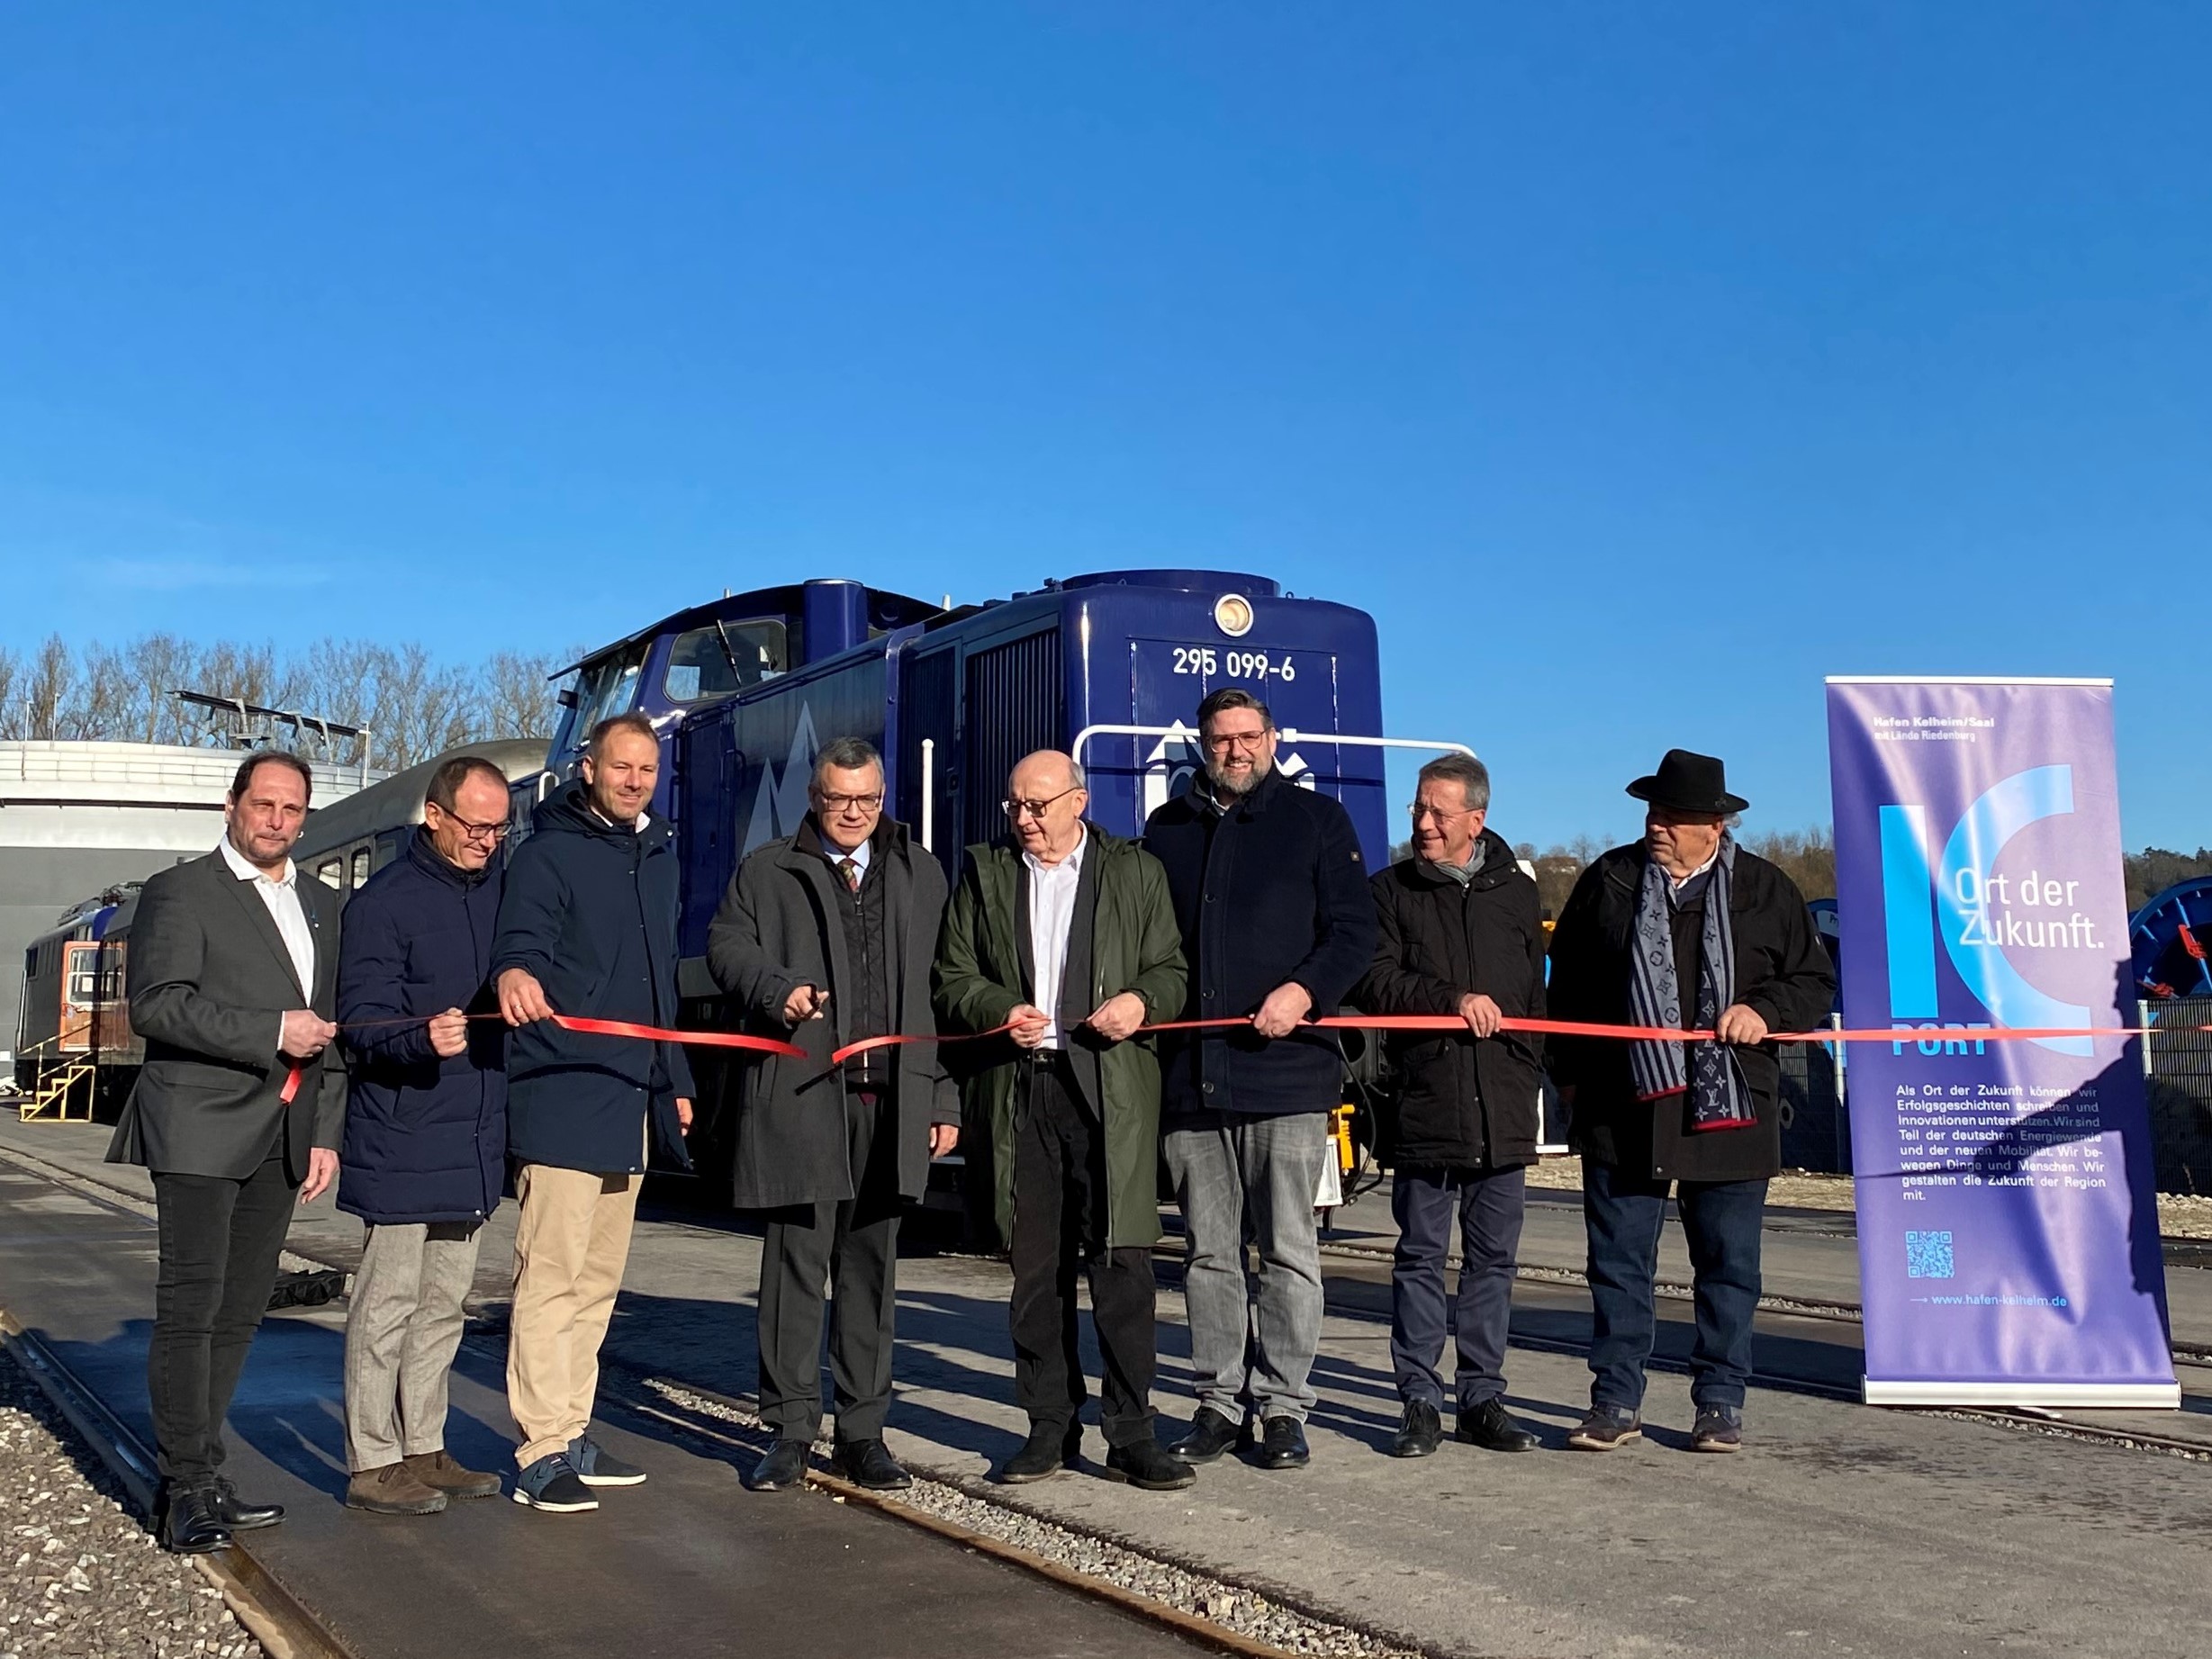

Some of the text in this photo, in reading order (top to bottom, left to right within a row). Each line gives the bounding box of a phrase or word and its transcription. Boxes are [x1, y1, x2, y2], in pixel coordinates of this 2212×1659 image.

[1173, 647, 1295, 681] 295 099-6
[1873, 717, 1994, 727] Hafen Kelheim/Saal
[1874, 731, 1889, 740] mit
[1921, 730, 1975, 743] Riedenburg
[1955, 867, 2079, 907] Ort der
[1957, 908, 2104, 950] Zukunft.
[1891, 1023, 1991, 1056] PORT
[1896, 1085, 2097, 1097] Als Ort der Zukunft können wir
[1897, 1100, 2099, 1113] Erfolgsgeschichten schreiben und
[1898, 1114, 1976, 1125] Innovationen
[2054, 1117, 2074, 1127] Wir
[2075, 1117, 2100, 1127] sind
[1899, 1129, 2101, 1144] Teil der deutschen Energiewende
[1901, 1144, 1923, 1155] und
[1929, 1144, 1949, 1155] der
[1955, 1145, 1992, 1156] neuen
[2057, 1146, 2078, 1158] Wir
[2084, 1146, 2103, 1158] be-
[1901, 1159, 2104, 1172] wegen Dinge und Menschen. Wir
[1902, 1175, 2106, 1189] gestalten die Zukunft der Region
[1903, 1189, 1926, 1201] mit.
[1931, 1294, 2067, 1307] www.hafen-kelheim.de
